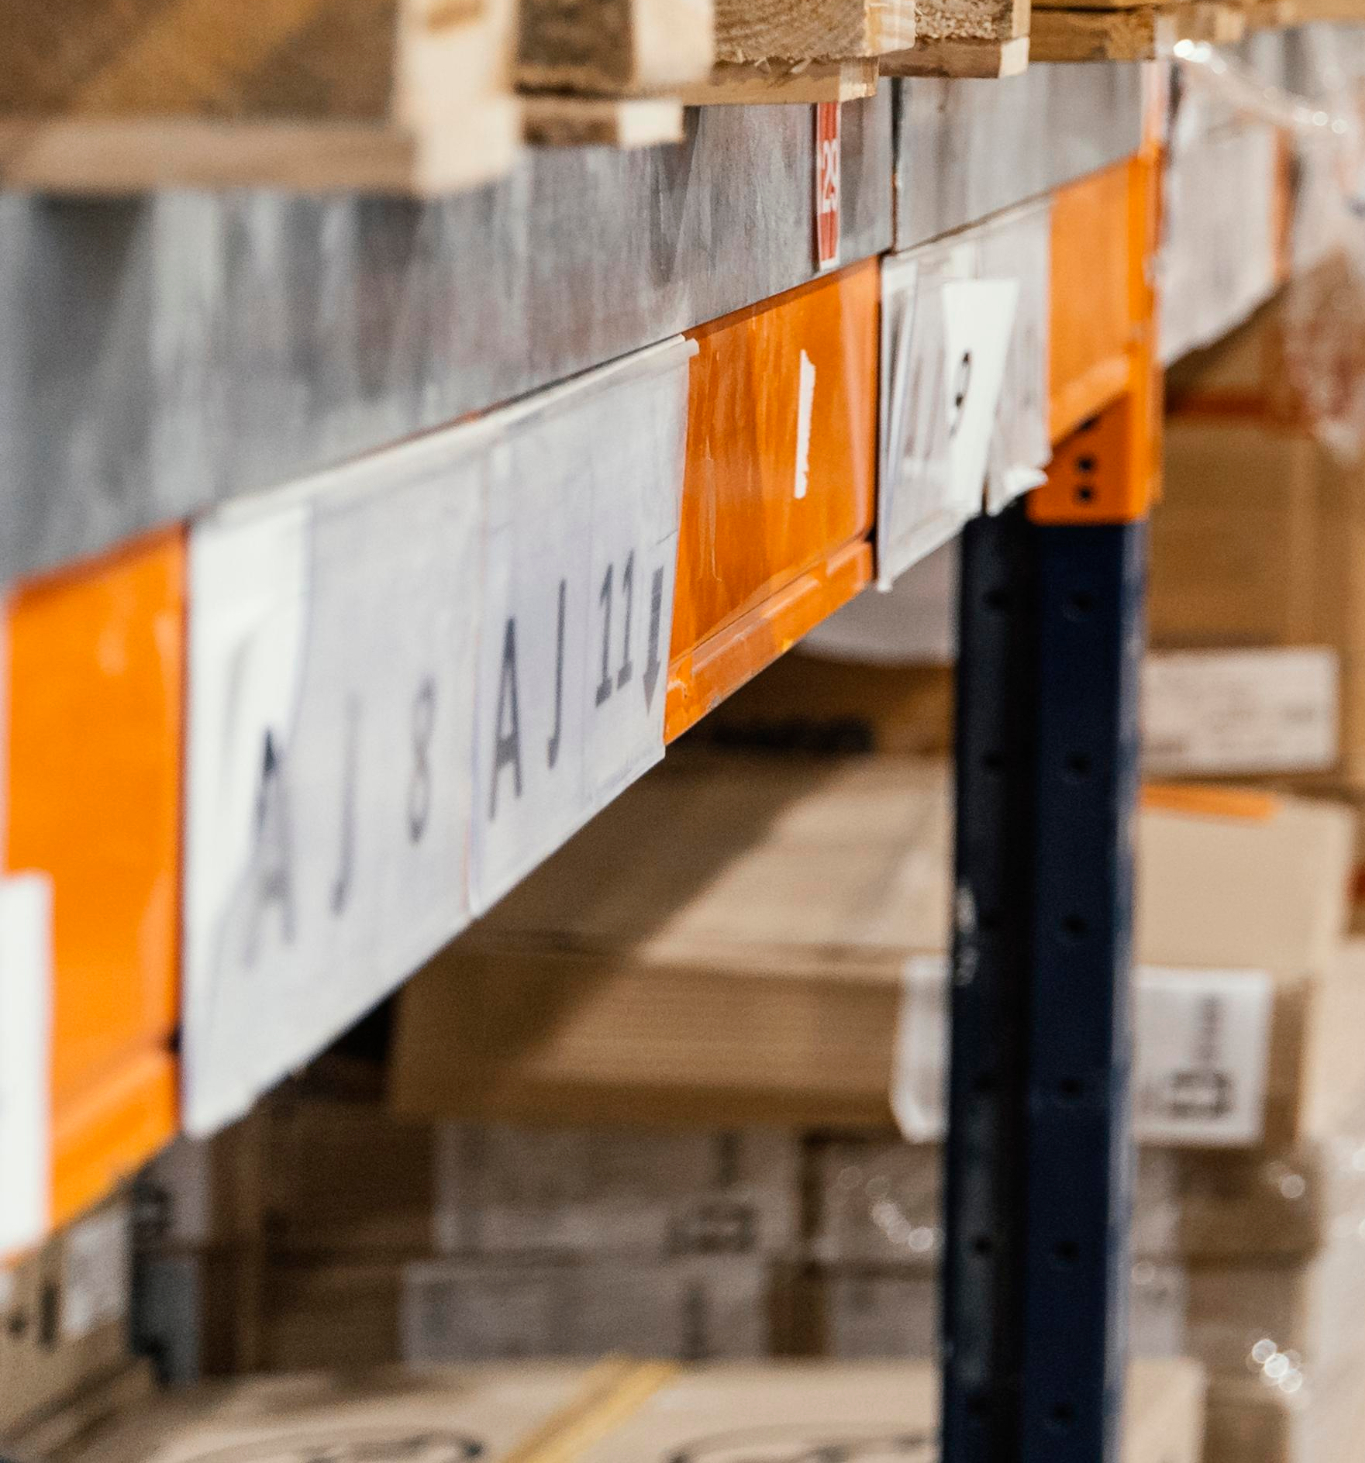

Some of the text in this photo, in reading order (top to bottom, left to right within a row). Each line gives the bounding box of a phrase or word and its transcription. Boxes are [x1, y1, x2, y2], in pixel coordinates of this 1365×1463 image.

[407, 675, 438, 844] 8
[488, 548, 637, 822] A J 11
